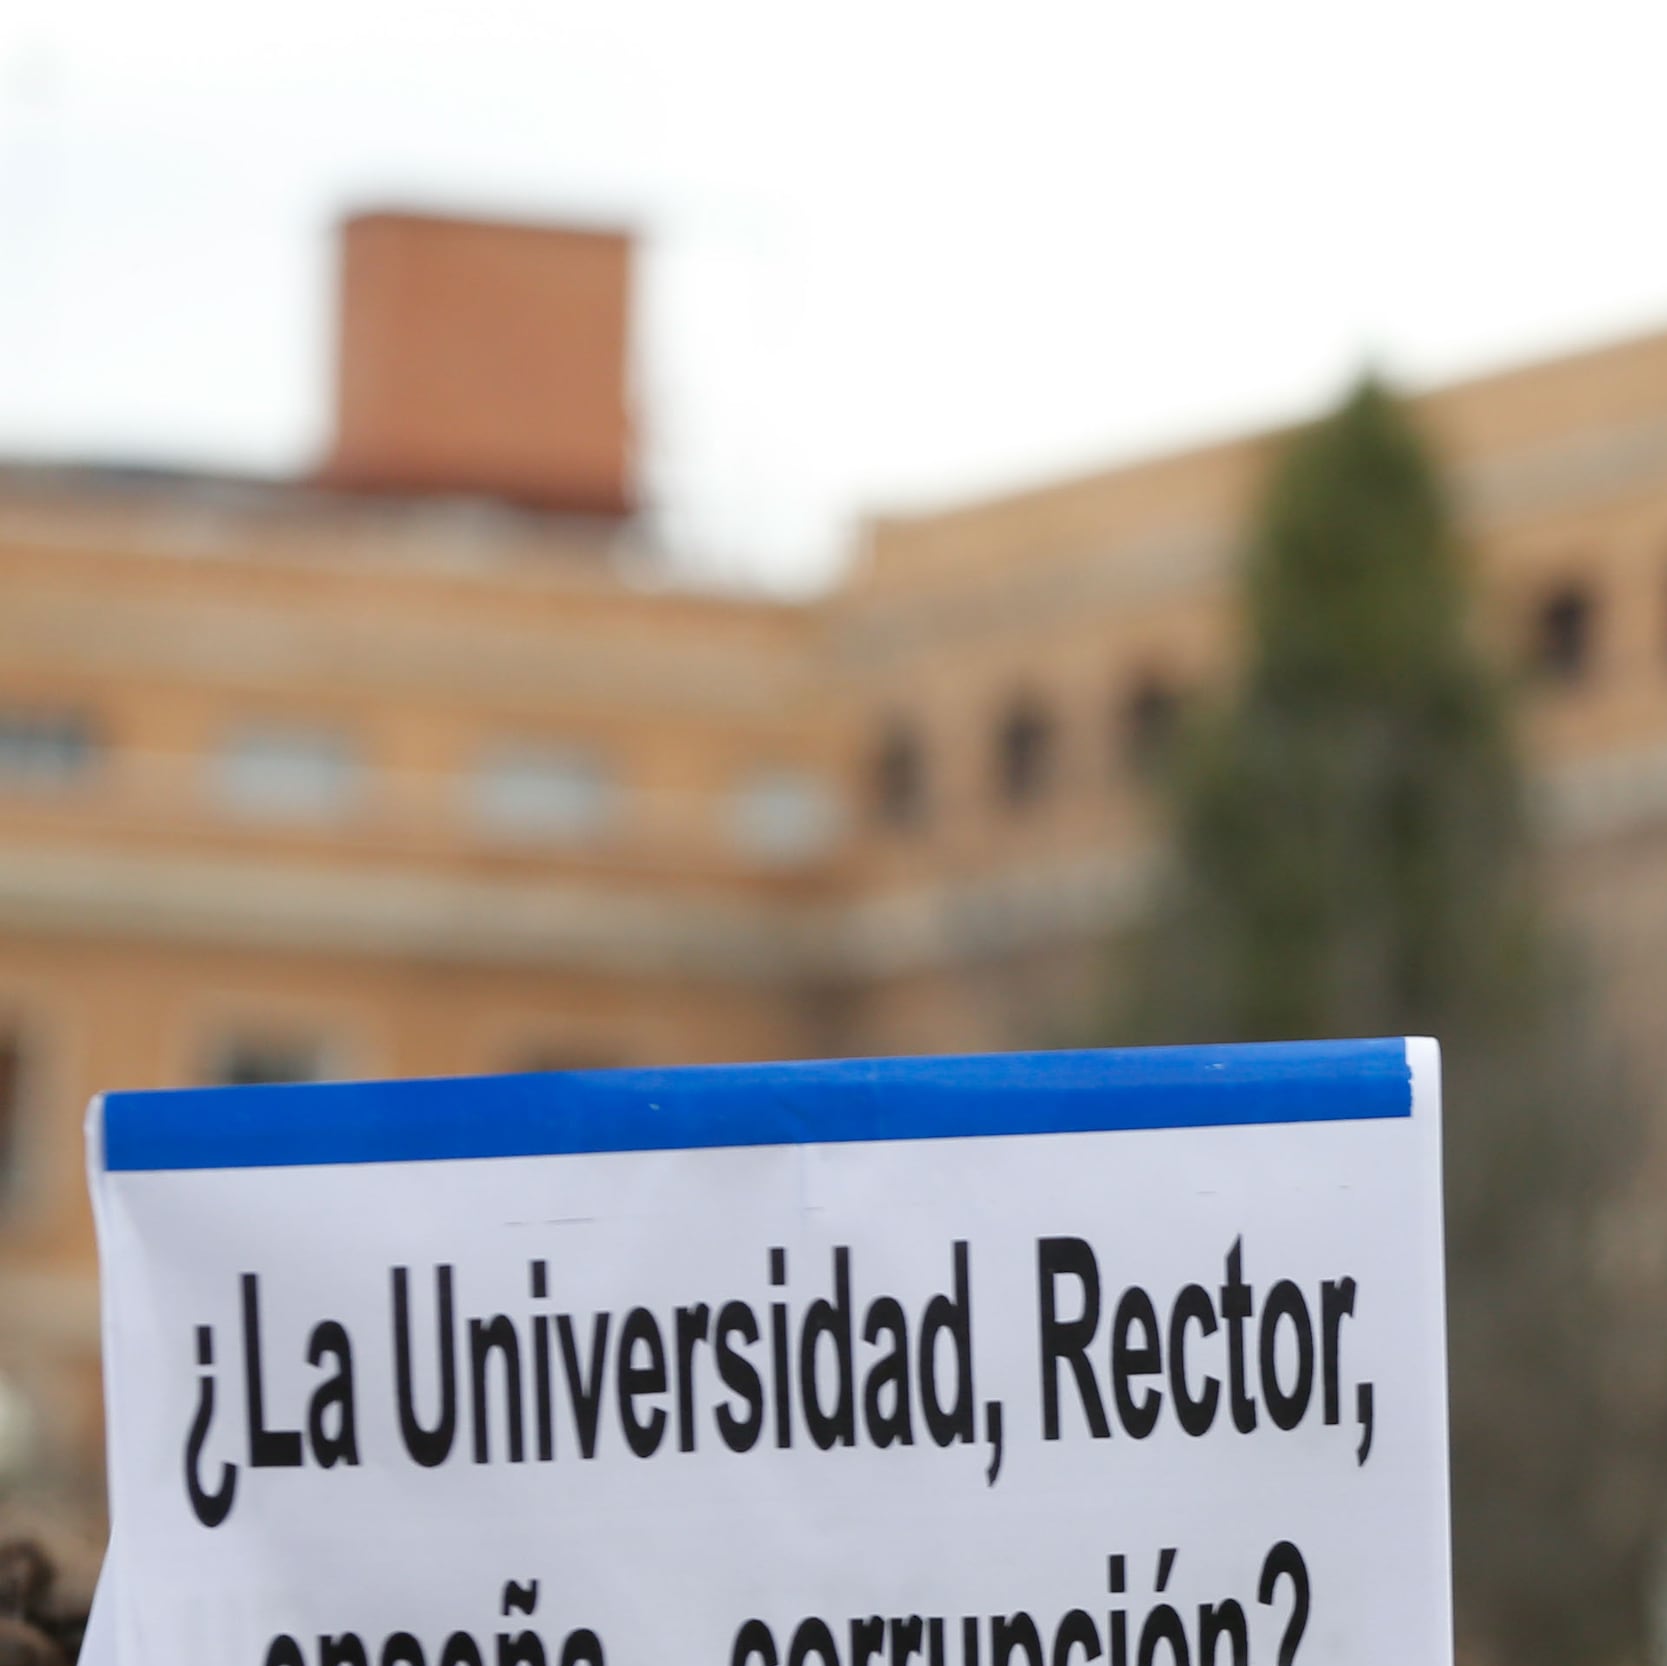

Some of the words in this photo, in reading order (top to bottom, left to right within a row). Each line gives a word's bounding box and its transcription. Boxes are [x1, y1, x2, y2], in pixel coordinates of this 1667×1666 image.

[184, 1272, 361, 1530] ¿La
[391, 1236, 1005, 1487] Universidad,
[1036, 1235, 1376, 1468] Rector,
